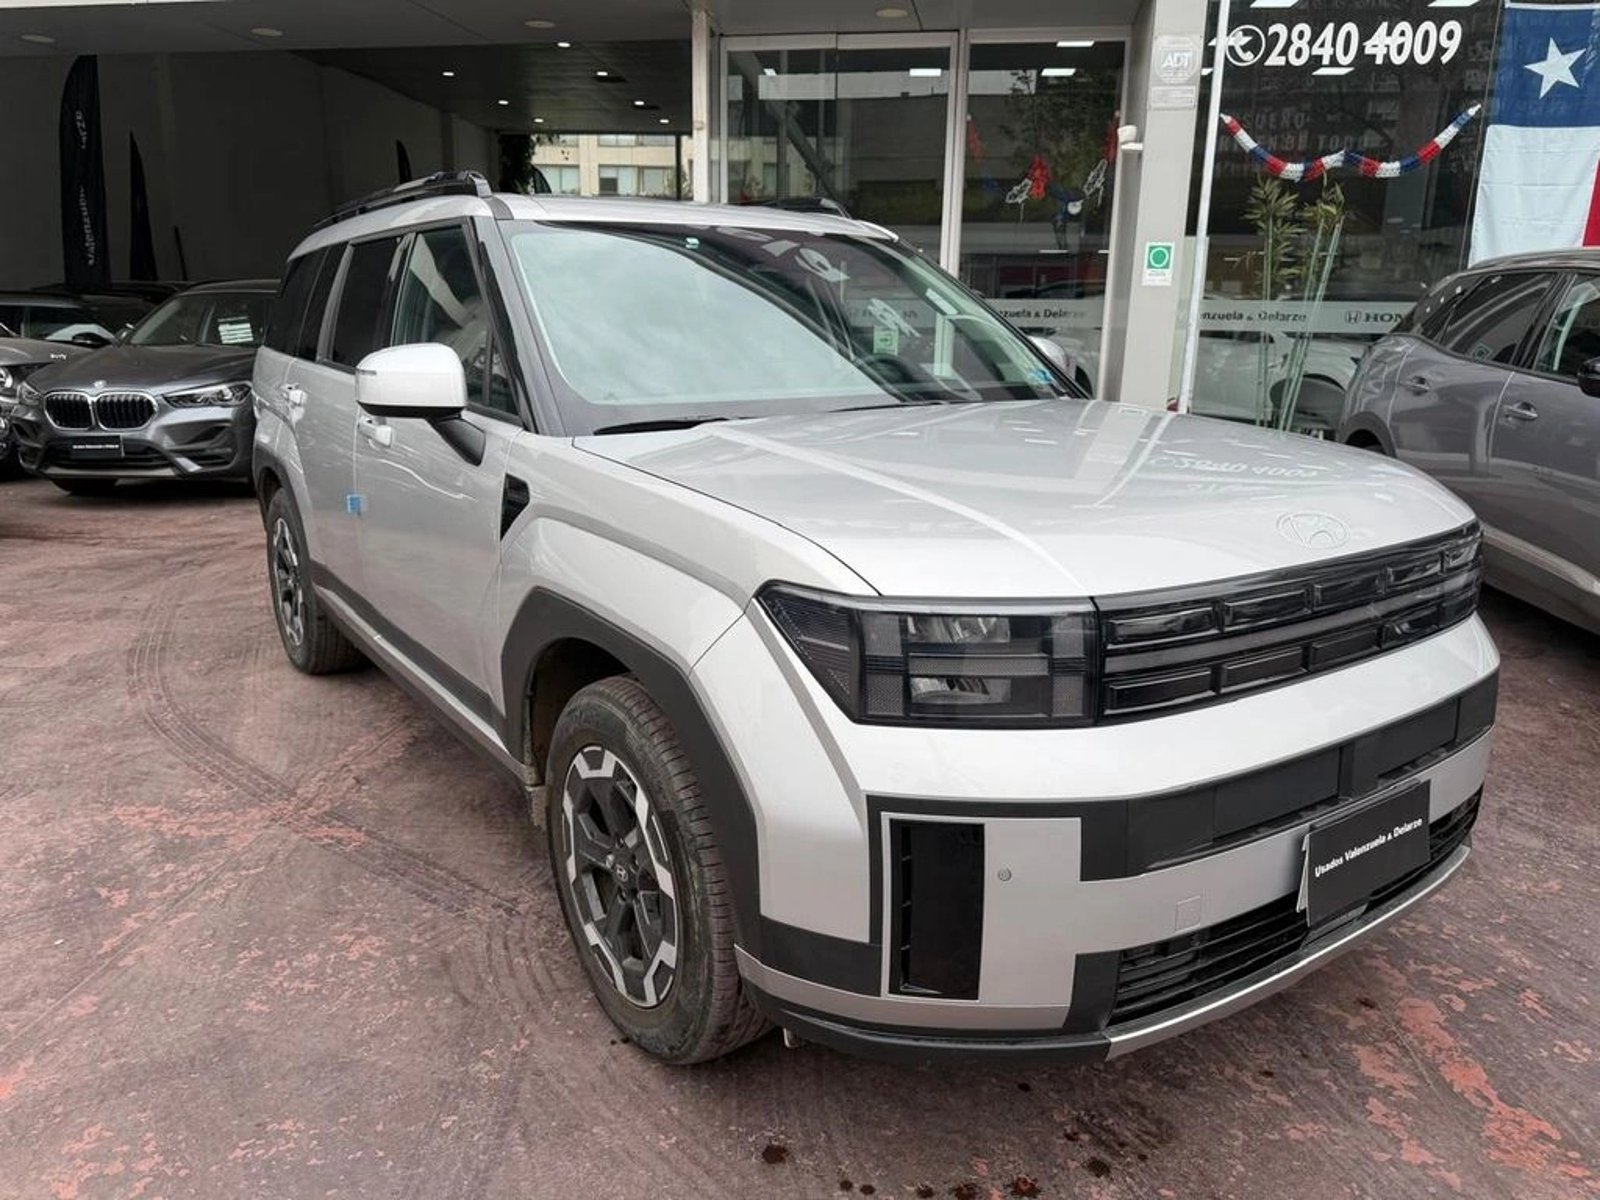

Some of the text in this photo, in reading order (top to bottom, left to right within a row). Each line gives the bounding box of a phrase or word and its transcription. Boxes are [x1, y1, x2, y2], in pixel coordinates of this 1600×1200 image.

[1162, 51, 1192, 68] ADT
[1264, 20, 1463, 67] 2840 4009
[1315, 856, 1344, 878] Usados
[1345, 833, 1387, 861] Valenzuela
[1393, 817, 1423, 838] Delarze
